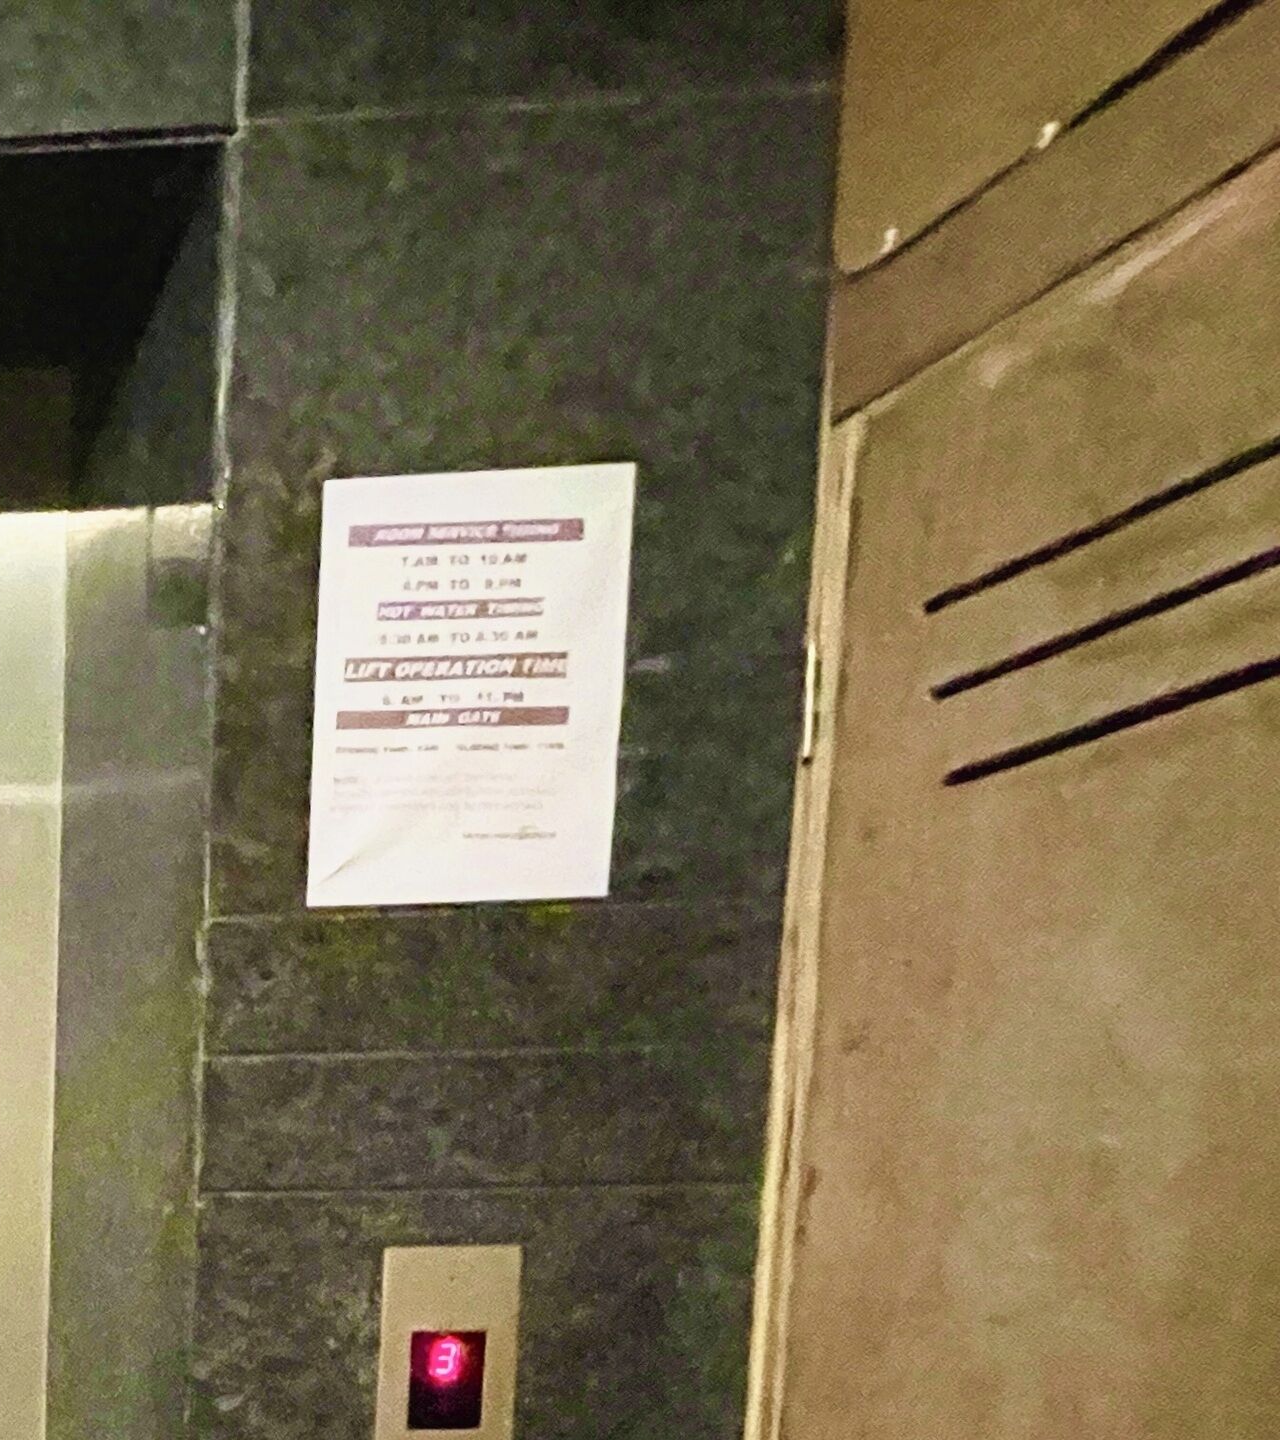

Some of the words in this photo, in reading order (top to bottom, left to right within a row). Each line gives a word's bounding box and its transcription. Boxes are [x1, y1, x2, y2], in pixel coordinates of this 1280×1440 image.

[450, 554, 470, 565] TO
[450, 579, 470, 590] TO
[450, 631, 471, 644] TO
[344, 662, 393, 679] LIFT
[395, 657, 517, 678] OPERATION
[434, 1342, 457, 1375] 3
